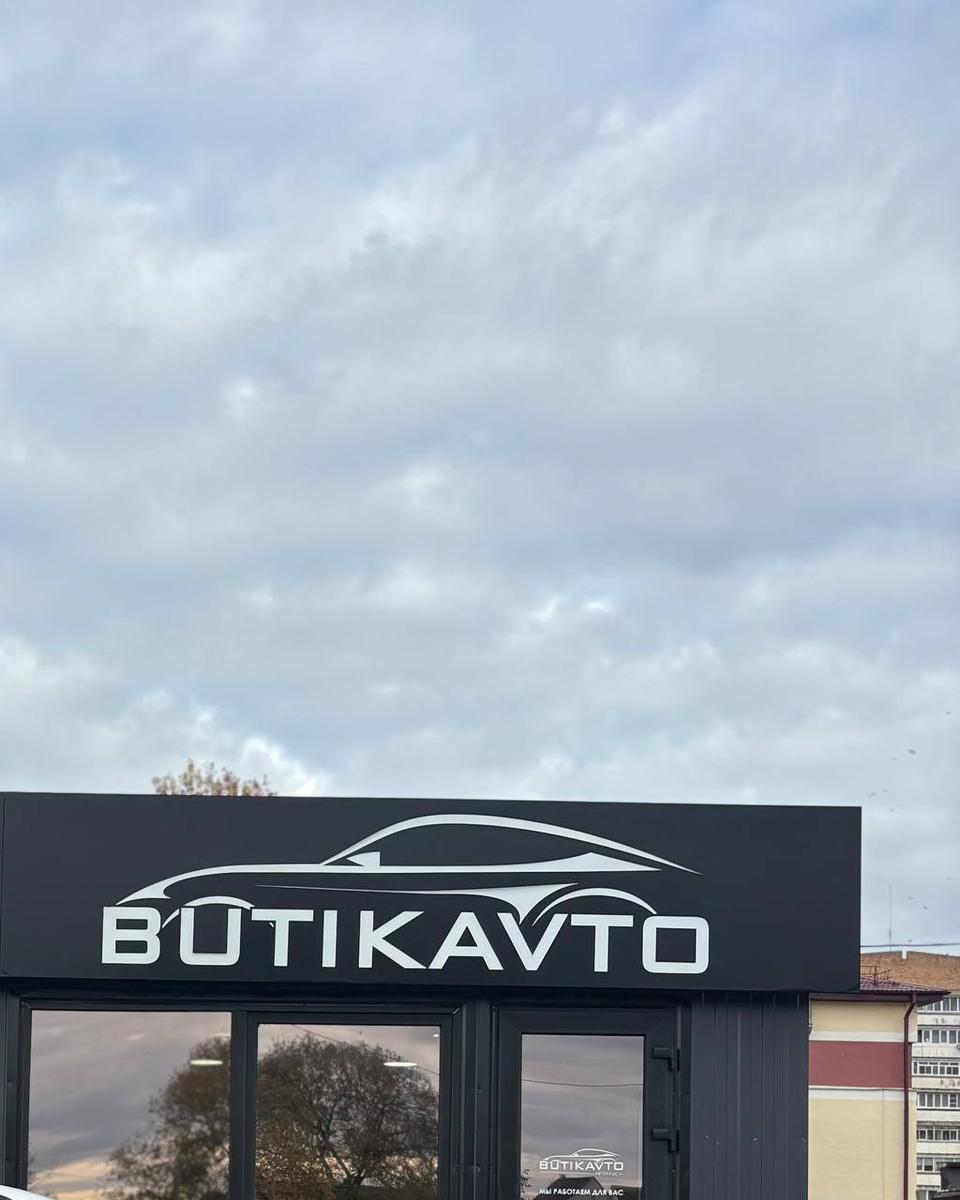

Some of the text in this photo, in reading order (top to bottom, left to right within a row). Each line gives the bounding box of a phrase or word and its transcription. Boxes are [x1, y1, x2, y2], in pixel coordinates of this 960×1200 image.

[101, 902, 710, 975] BUTIKAVTO
[539, 1160, 624, 1171] BUTIKAVTO
[553, 1188, 591, 1196] РАБОТАЕМ
[592, 1189, 607, 1197] ДЛЯ
